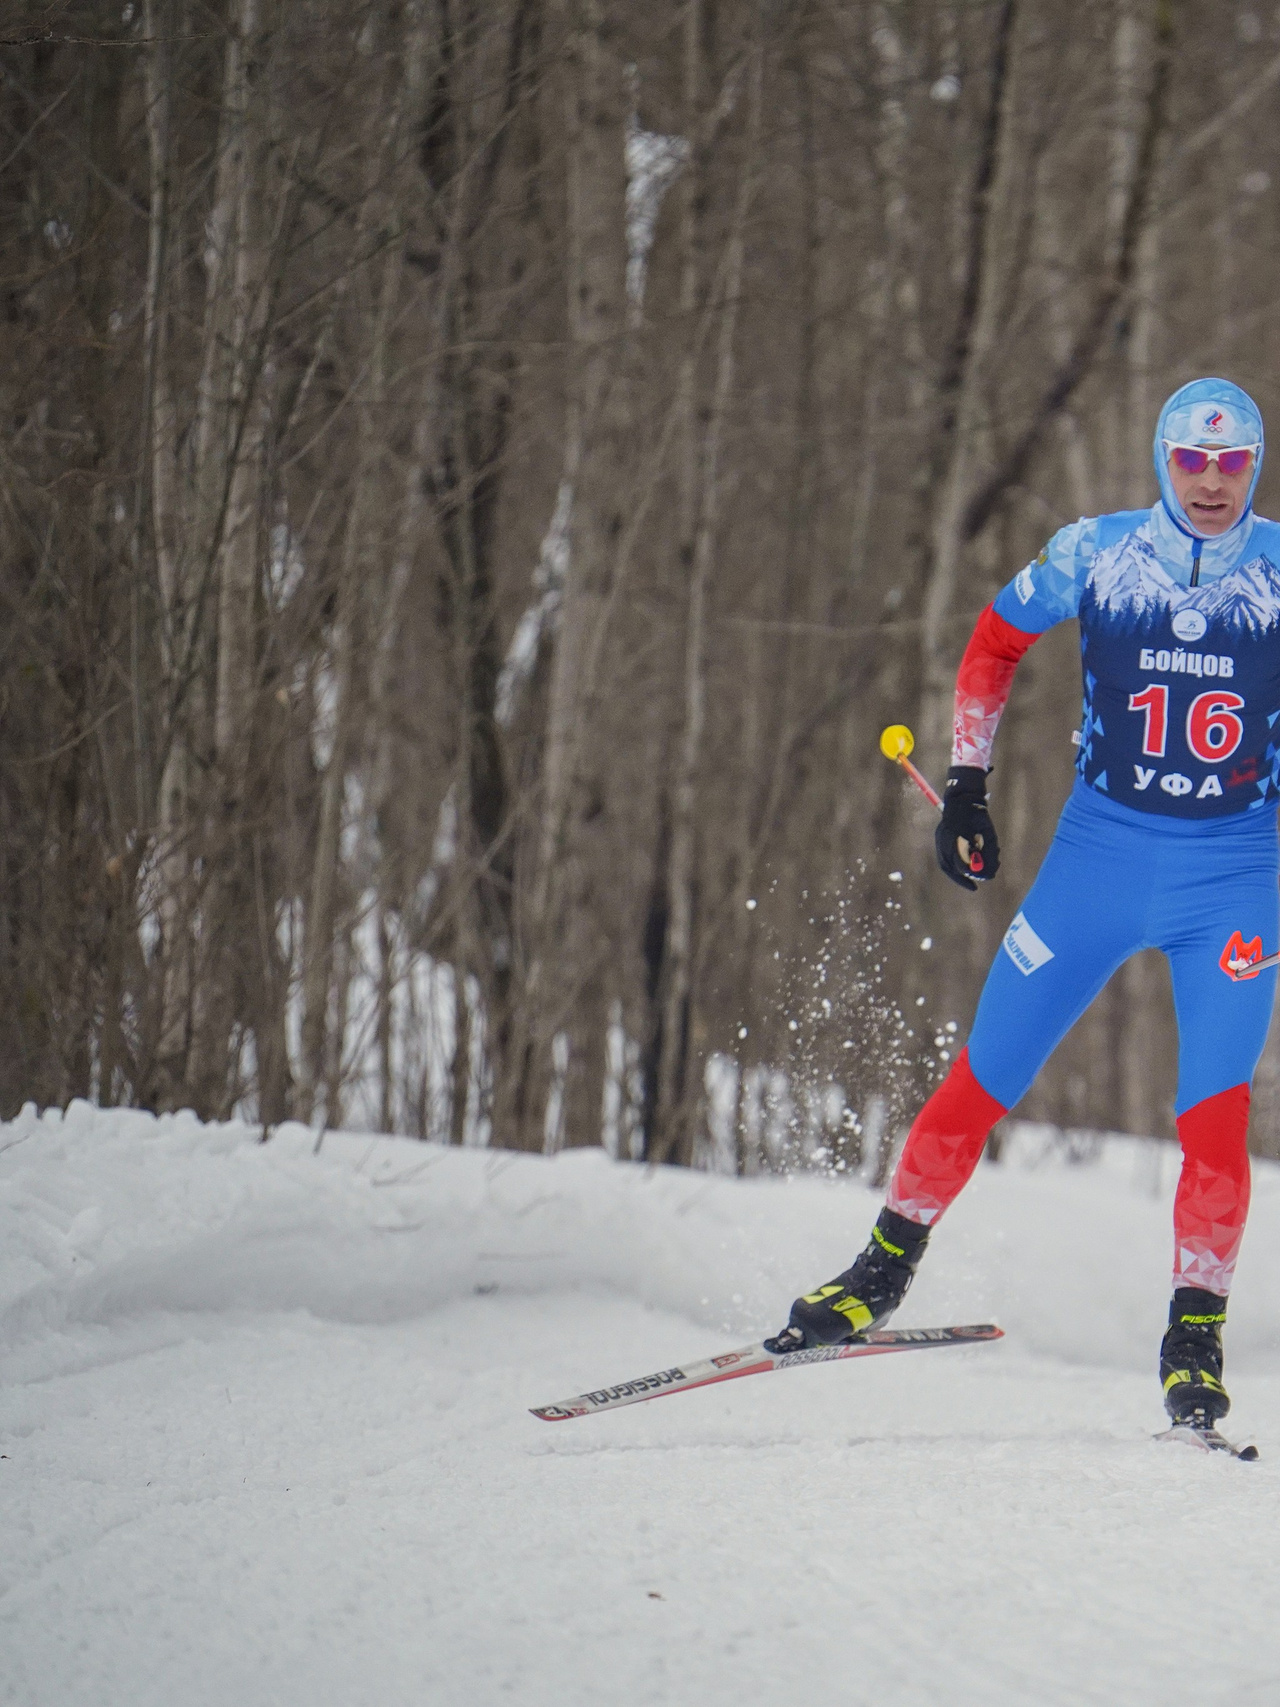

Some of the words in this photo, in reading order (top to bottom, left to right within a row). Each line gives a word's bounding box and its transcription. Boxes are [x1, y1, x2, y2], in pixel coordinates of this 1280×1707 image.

[1139, 647, 1234, 677] БОЙЦОВ
[1128, 683, 1245, 763] 16
[1133, 764, 1223, 799] УФА
[580, 1367, 687, 1406] ROSSIGNOL
